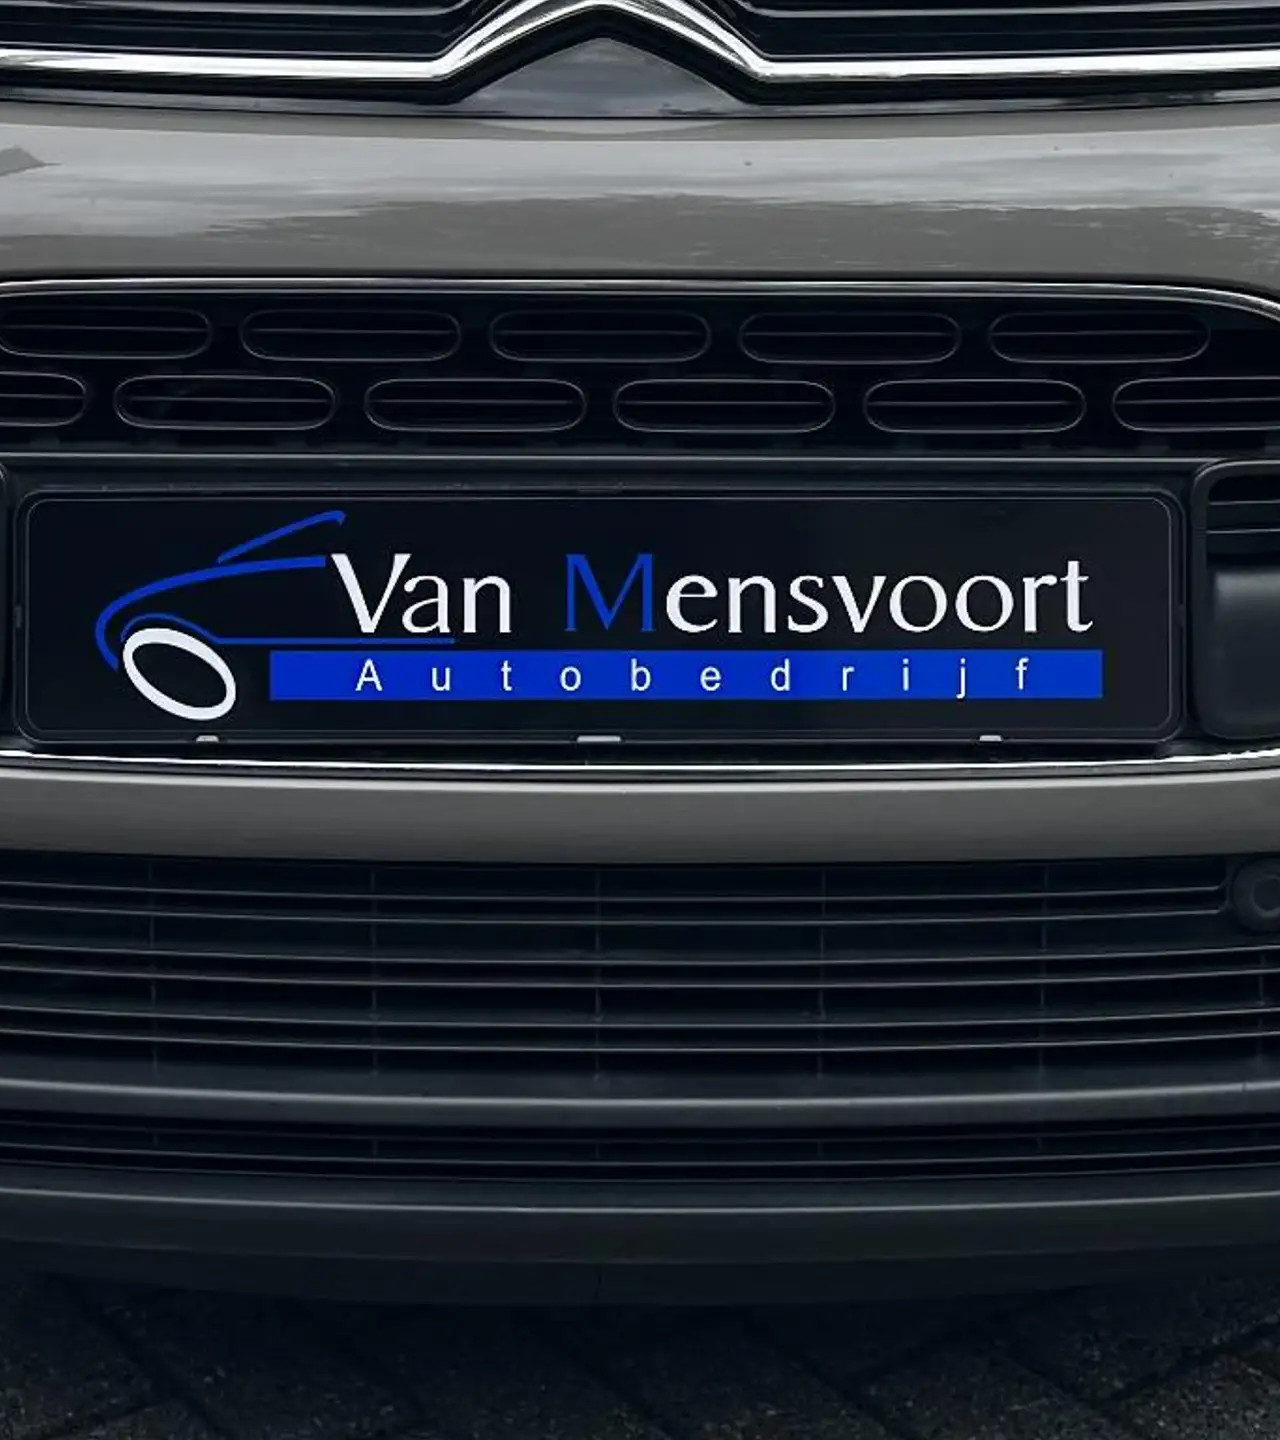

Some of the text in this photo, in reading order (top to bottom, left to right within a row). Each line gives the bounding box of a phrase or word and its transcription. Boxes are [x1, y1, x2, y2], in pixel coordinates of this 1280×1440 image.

[331, 553, 1094, 634] Van Mensvoort
[355, 658, 1030, 700] Autobedrijf
